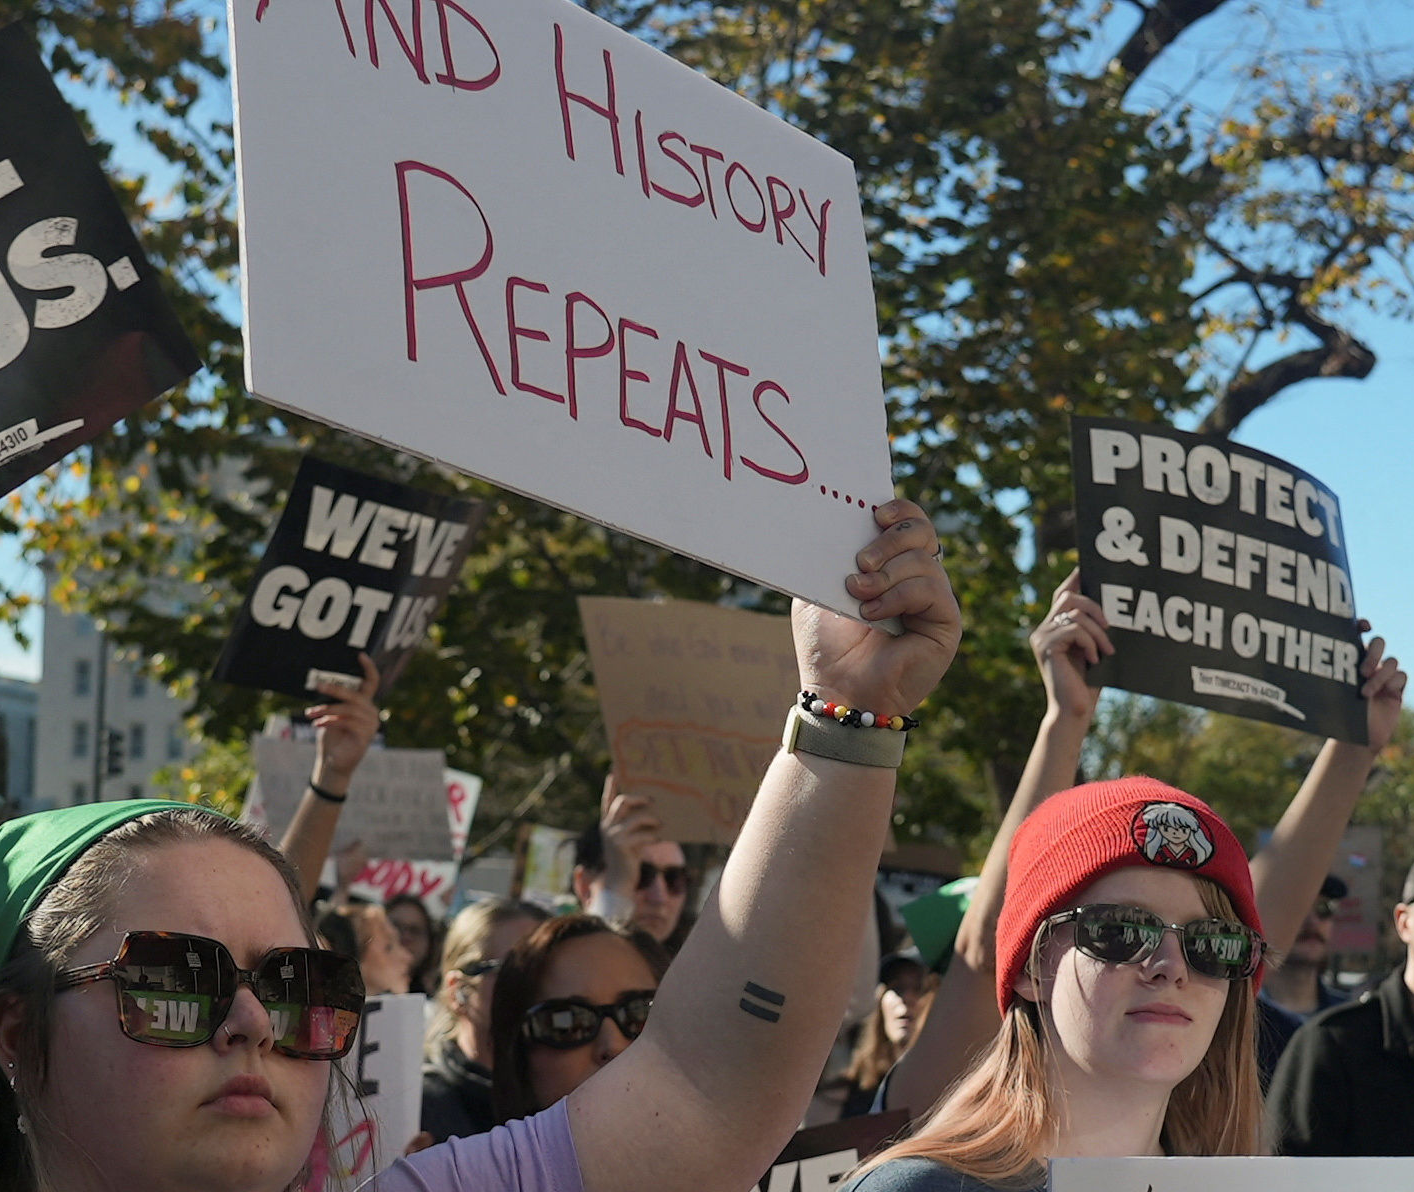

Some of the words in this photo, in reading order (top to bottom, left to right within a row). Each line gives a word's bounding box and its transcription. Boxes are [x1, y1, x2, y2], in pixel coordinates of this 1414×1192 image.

[552, 23, 833, 276] HISTORY
[303, 484, 470, 578] WE'VE
[1089, 427, 1341, 548] PROTECT
[249, 564, 394, 649] GOT
[1094, 505, 1150, 567] &
[1158, 514, 1357, 620] DEFEND
[1099, 583, 1225, 650] EACH
[1230, 611, 1359, 687] OTHER
